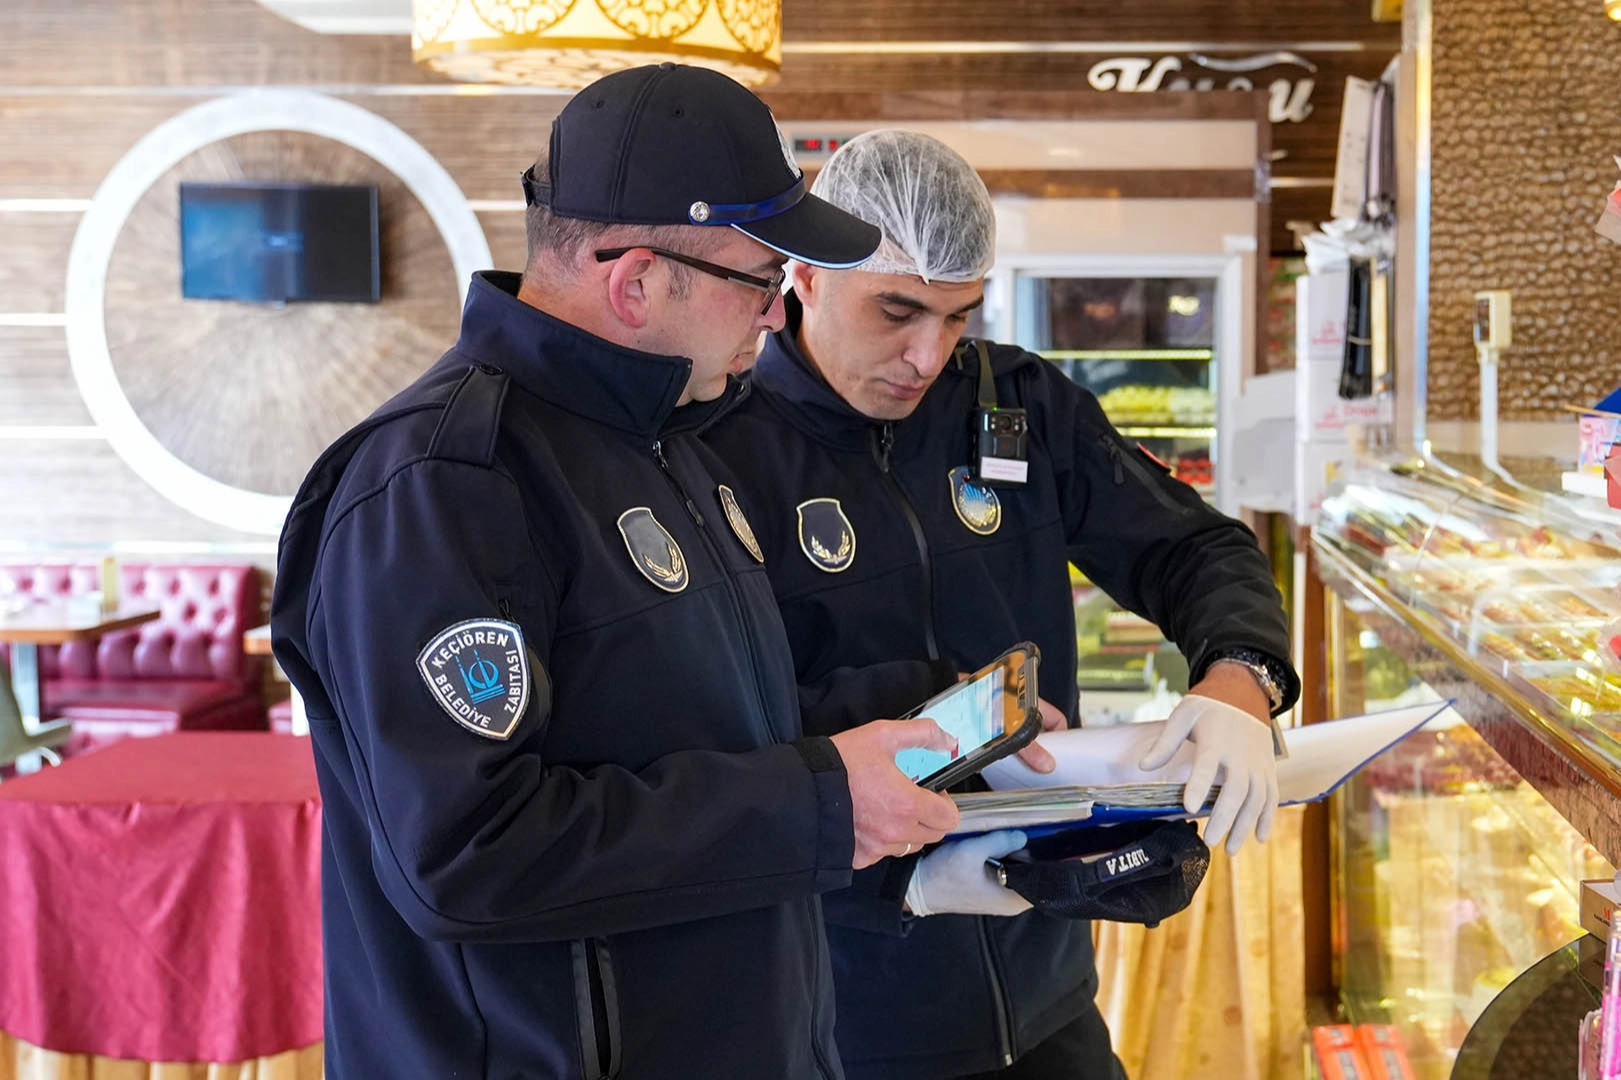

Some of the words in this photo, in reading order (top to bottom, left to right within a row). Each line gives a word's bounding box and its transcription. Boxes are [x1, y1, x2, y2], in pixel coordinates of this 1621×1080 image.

[431, 630, 509, 669] KEÇİÖREN
[435, 673, 492, 728] BELEDİYE
[504, 649, 521, 714] ZABITASI
